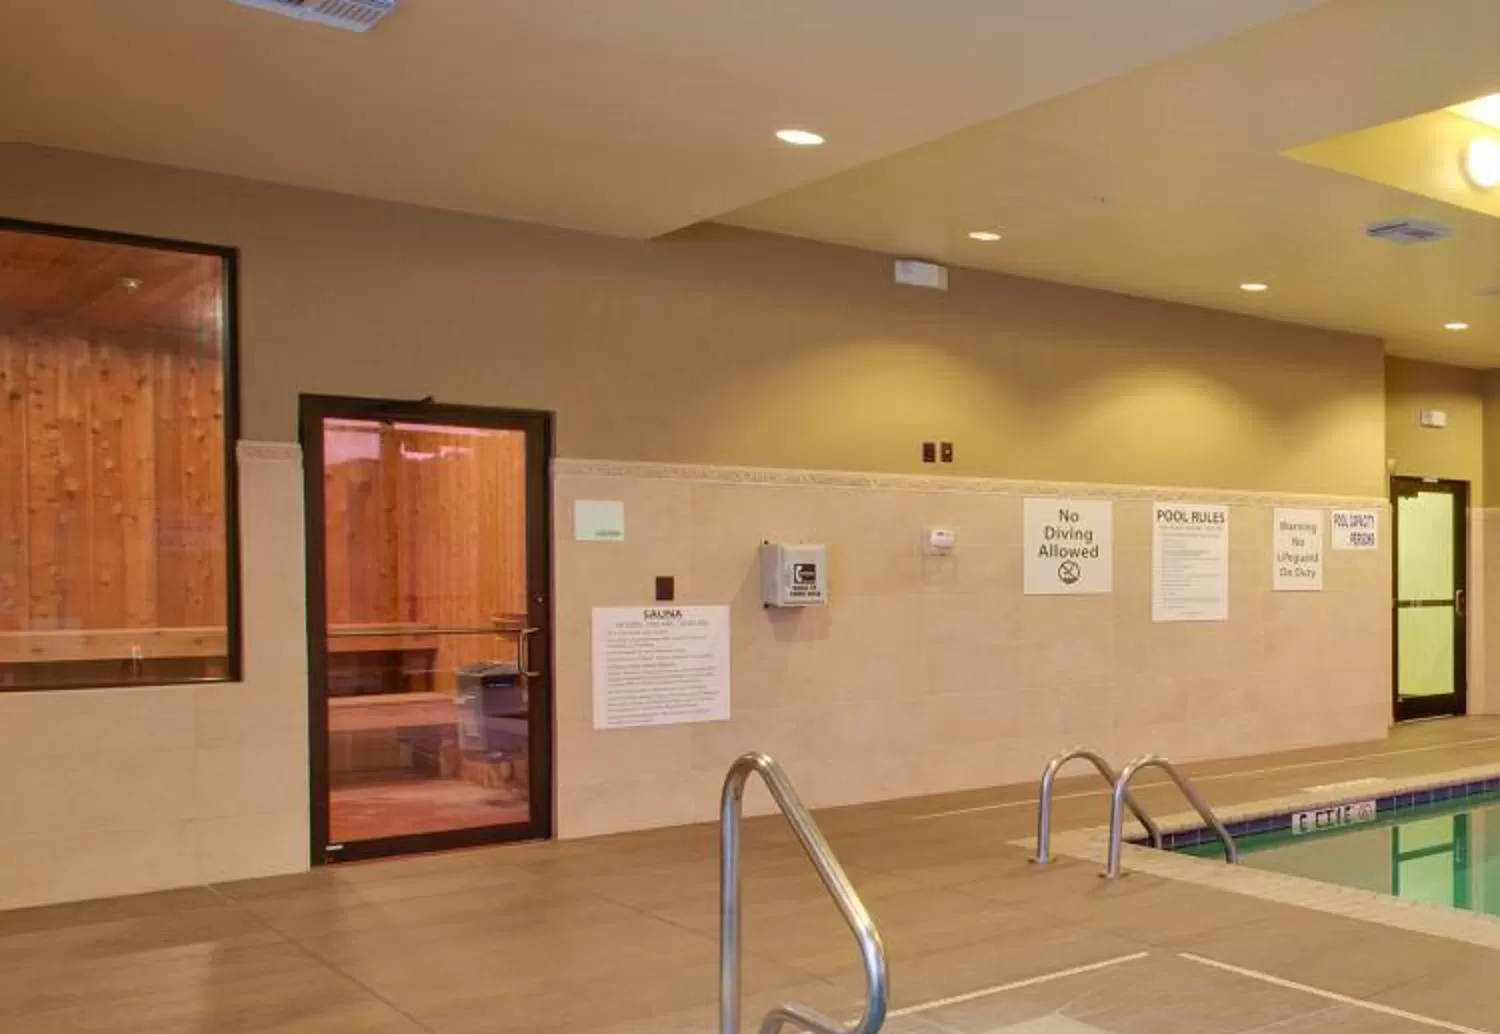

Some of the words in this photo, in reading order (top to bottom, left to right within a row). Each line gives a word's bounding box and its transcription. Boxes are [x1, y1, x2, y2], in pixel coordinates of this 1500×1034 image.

[1059, 508, 1080, 522] No
[1157, 509, 1188, 523] POOL
[1191, 511, 1225, 523] RULES
[1044, 525, 1093, 544] Diving
[1291, 537, 1304, 547] No
[1038, 544, 1099, 558] Allowed
[1277, 552, 1318, 565] Lifeguard
[1279, 568, 1292, 576] On
[1295, 568, 1316, 579] Duty
[643, 609, 682, 620] SAUNA
